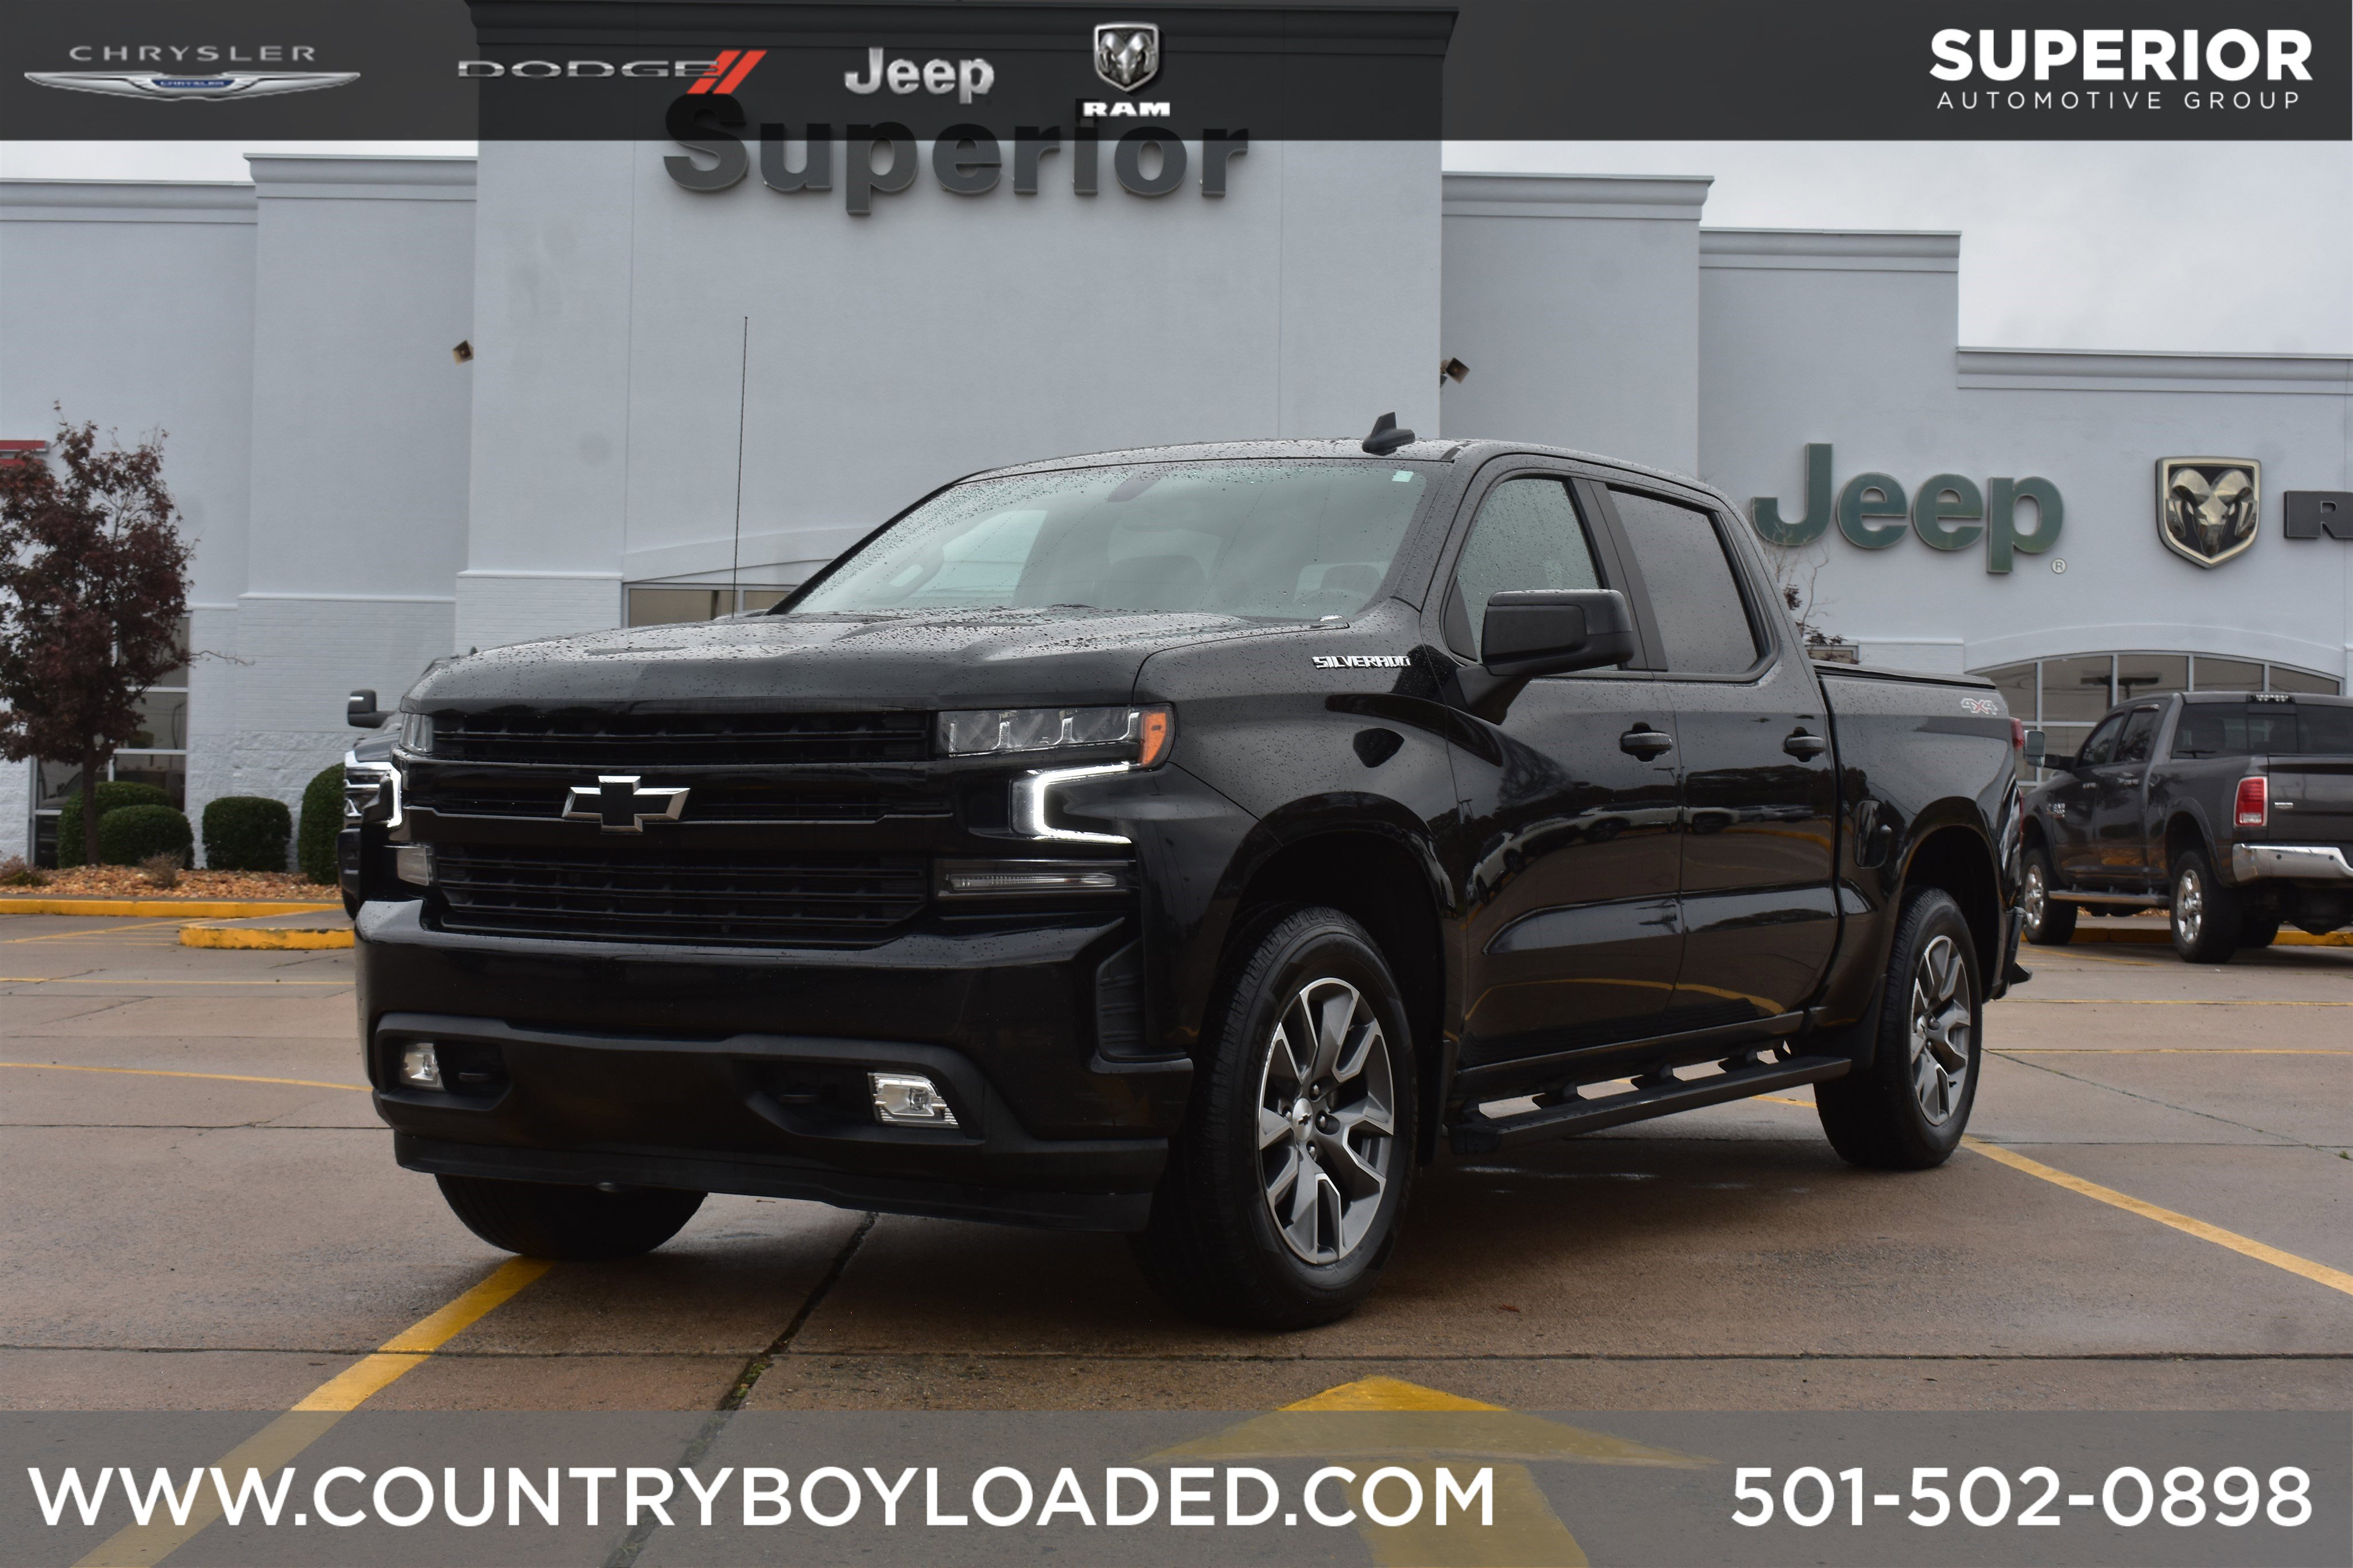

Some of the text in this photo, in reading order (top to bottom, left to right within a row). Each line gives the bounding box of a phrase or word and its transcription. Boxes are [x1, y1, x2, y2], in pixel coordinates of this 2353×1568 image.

[664, 90, 1249, 215] Superior
[1750, 442, 2063, 574] Jeep
[1312, 655, 1411, 669] SILVERADO
